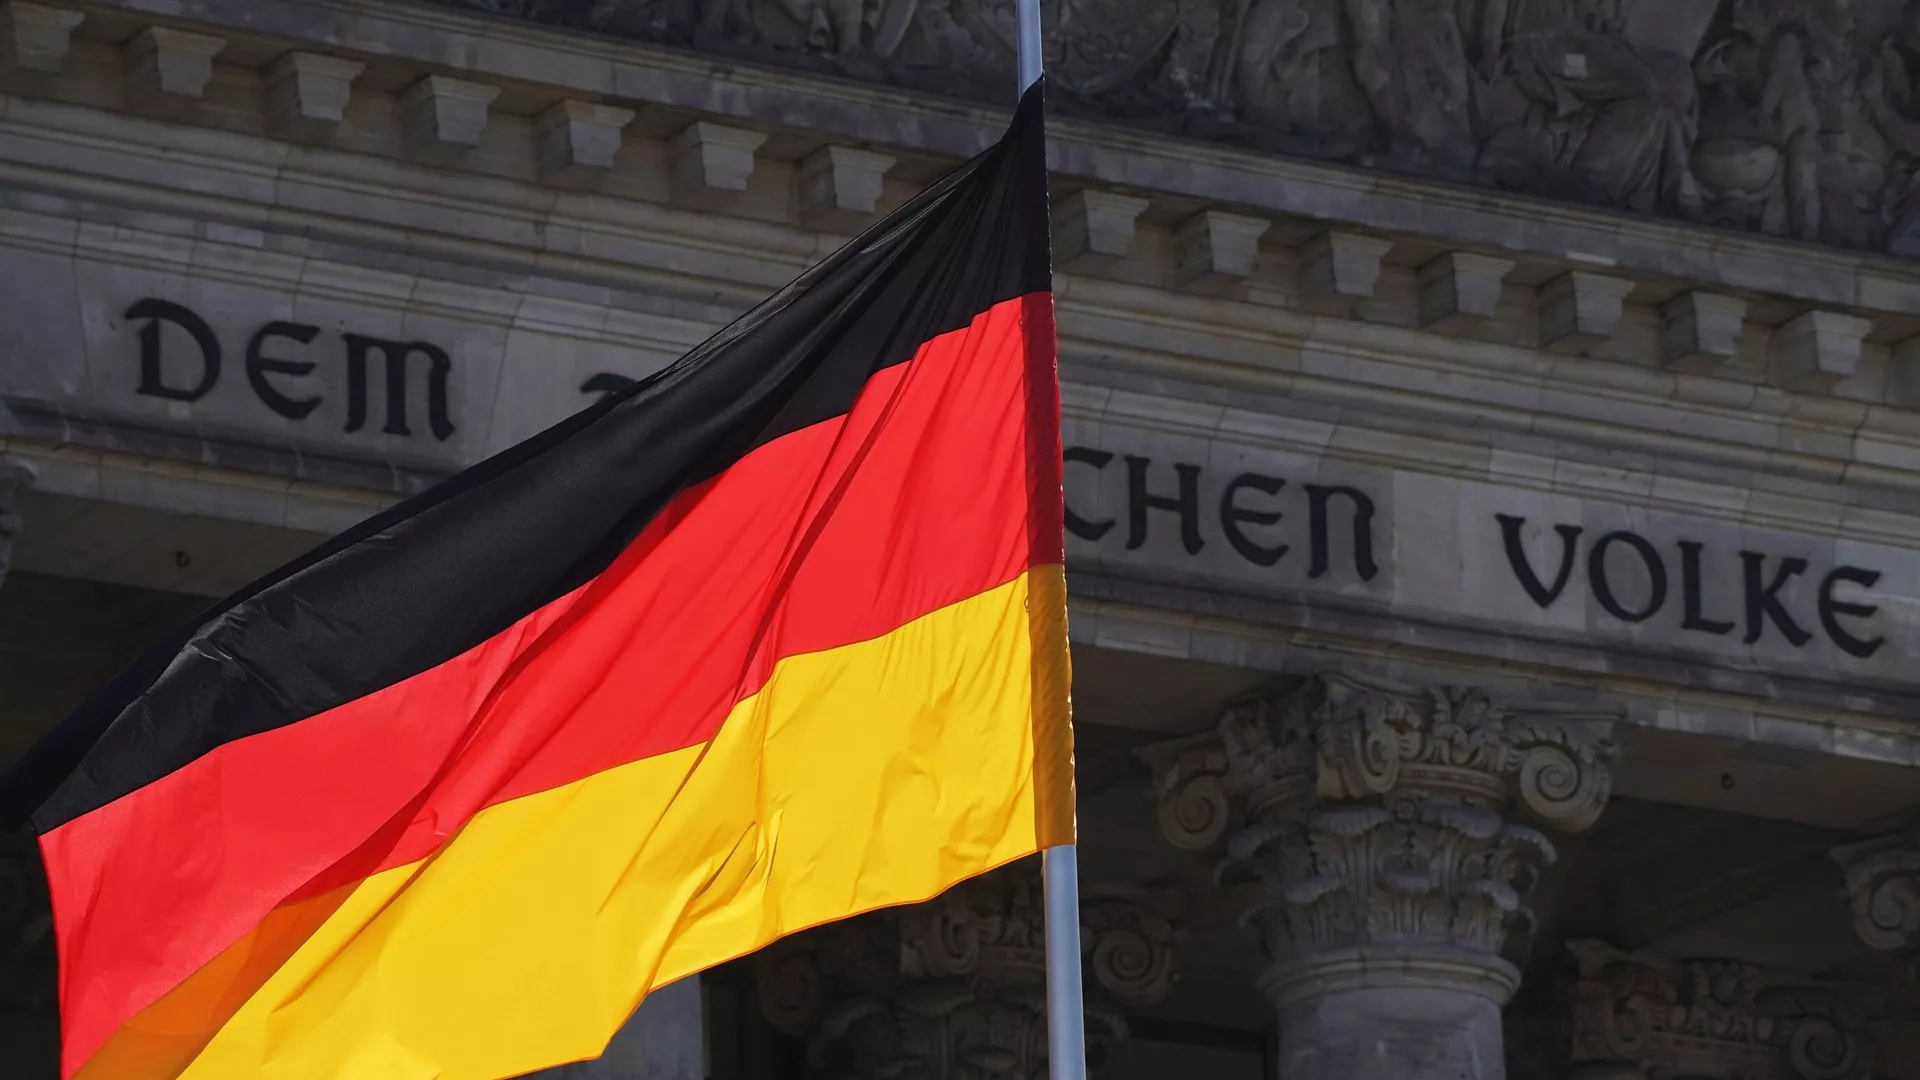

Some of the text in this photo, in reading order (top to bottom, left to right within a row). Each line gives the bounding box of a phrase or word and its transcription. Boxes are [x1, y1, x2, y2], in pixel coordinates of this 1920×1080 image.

[125, 298, 1885, 658] DEM CHEN VOLKE
